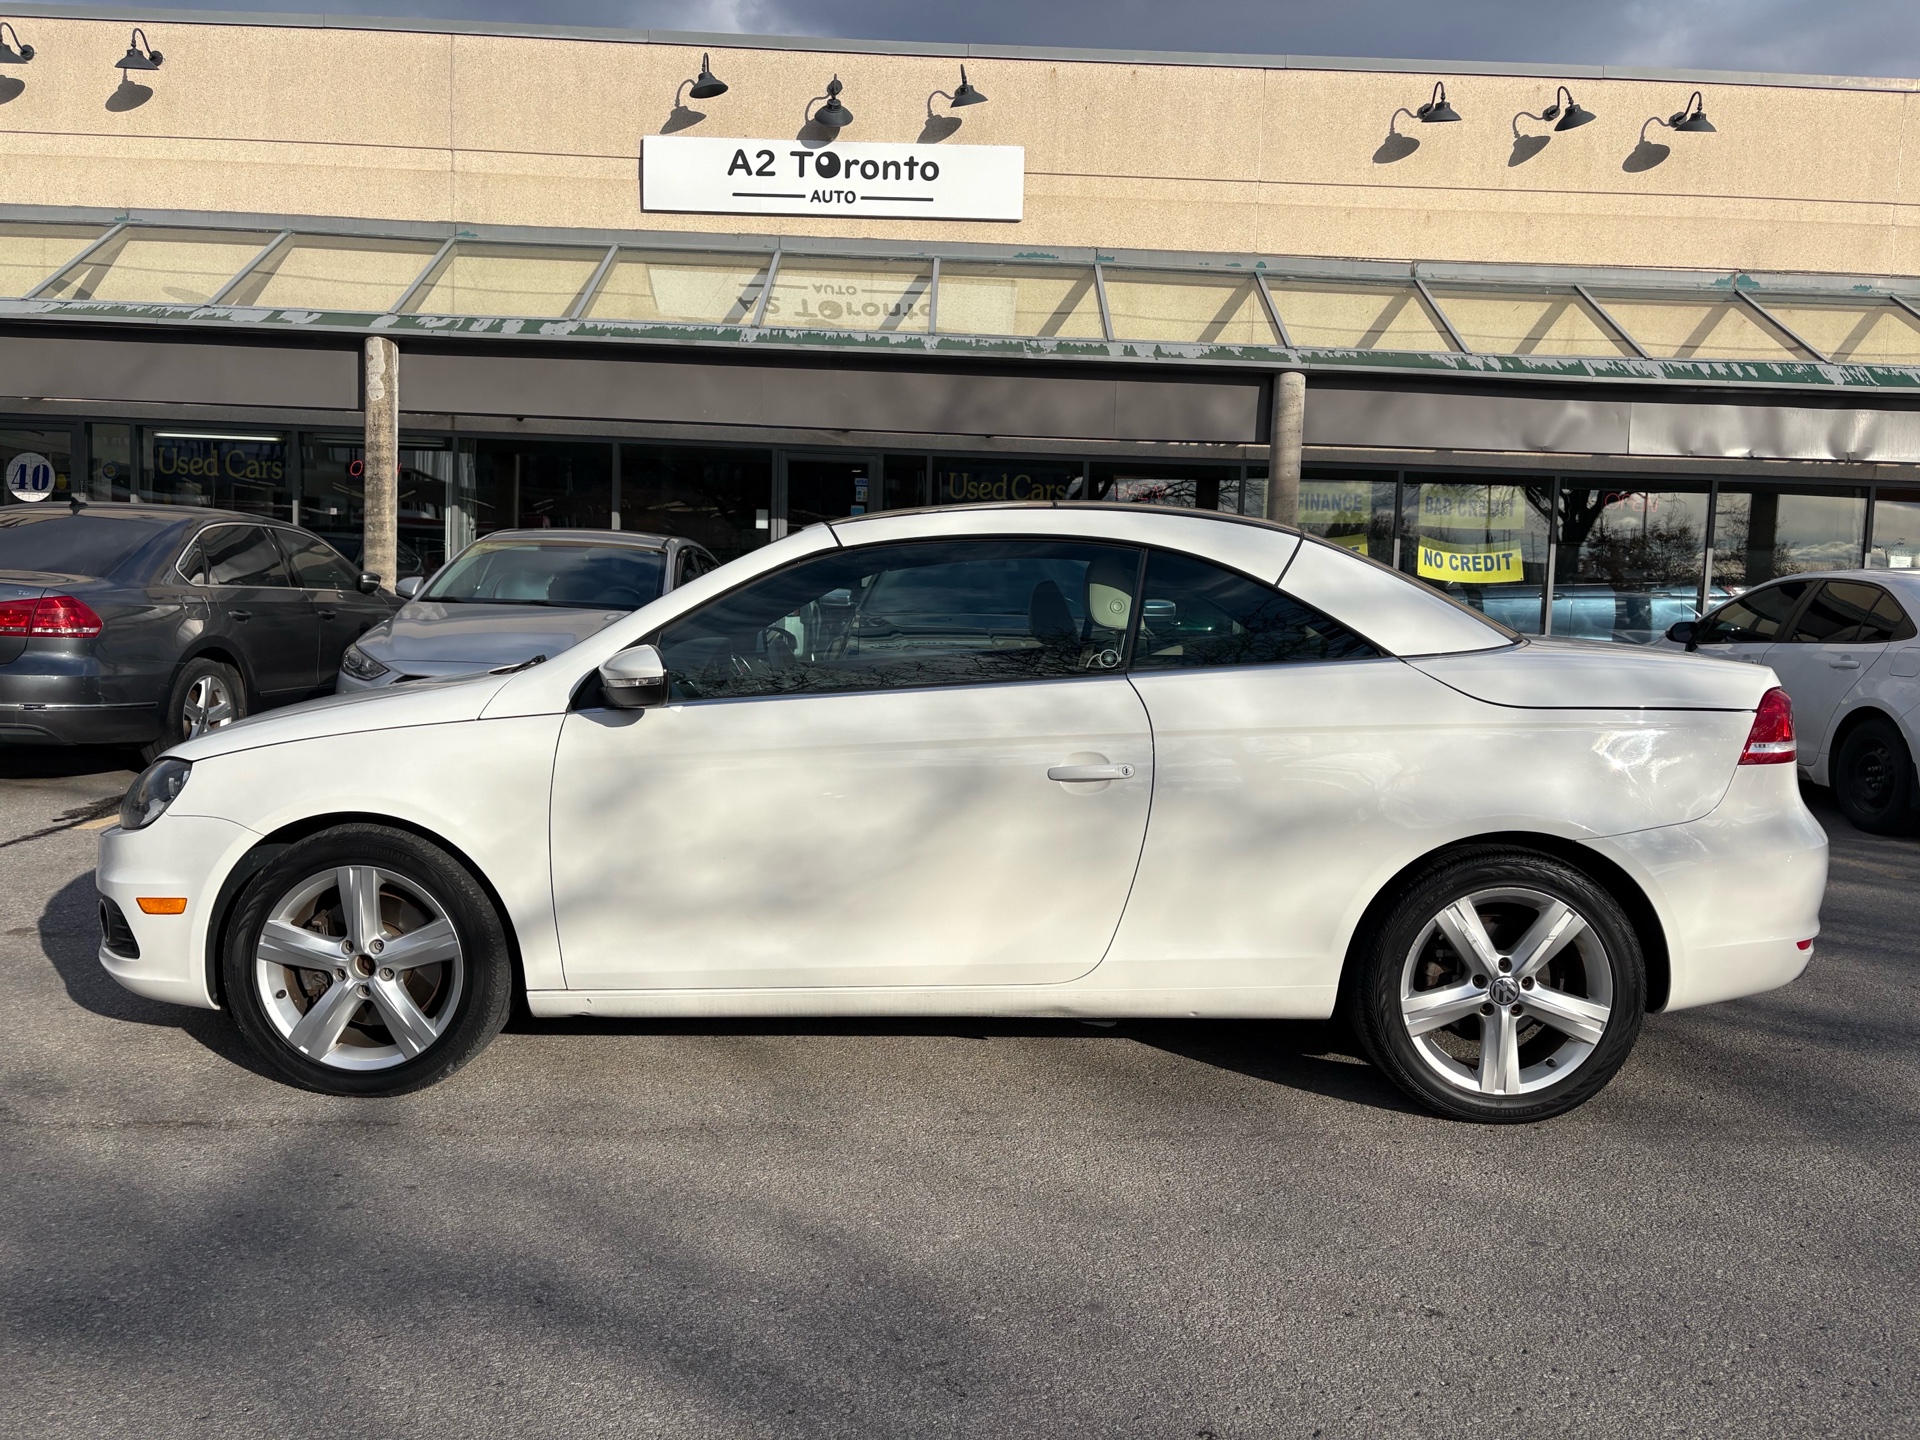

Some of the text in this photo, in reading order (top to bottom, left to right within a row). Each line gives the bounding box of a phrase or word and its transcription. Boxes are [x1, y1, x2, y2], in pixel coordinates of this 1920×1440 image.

[727, 149, 776, 177] A2
[810, 189, 857, 204] AUTO
[158, 447, 283, 480] Used Cars
[11, 463, 50, 491] 40
[948, 472, 1066, 500] Used Cars
[1298, 492, 1362, 511] FINANCE
[1425, 495, 1452, 516] BAD
[1424, 548, 1513, 573] NO CREDIT
